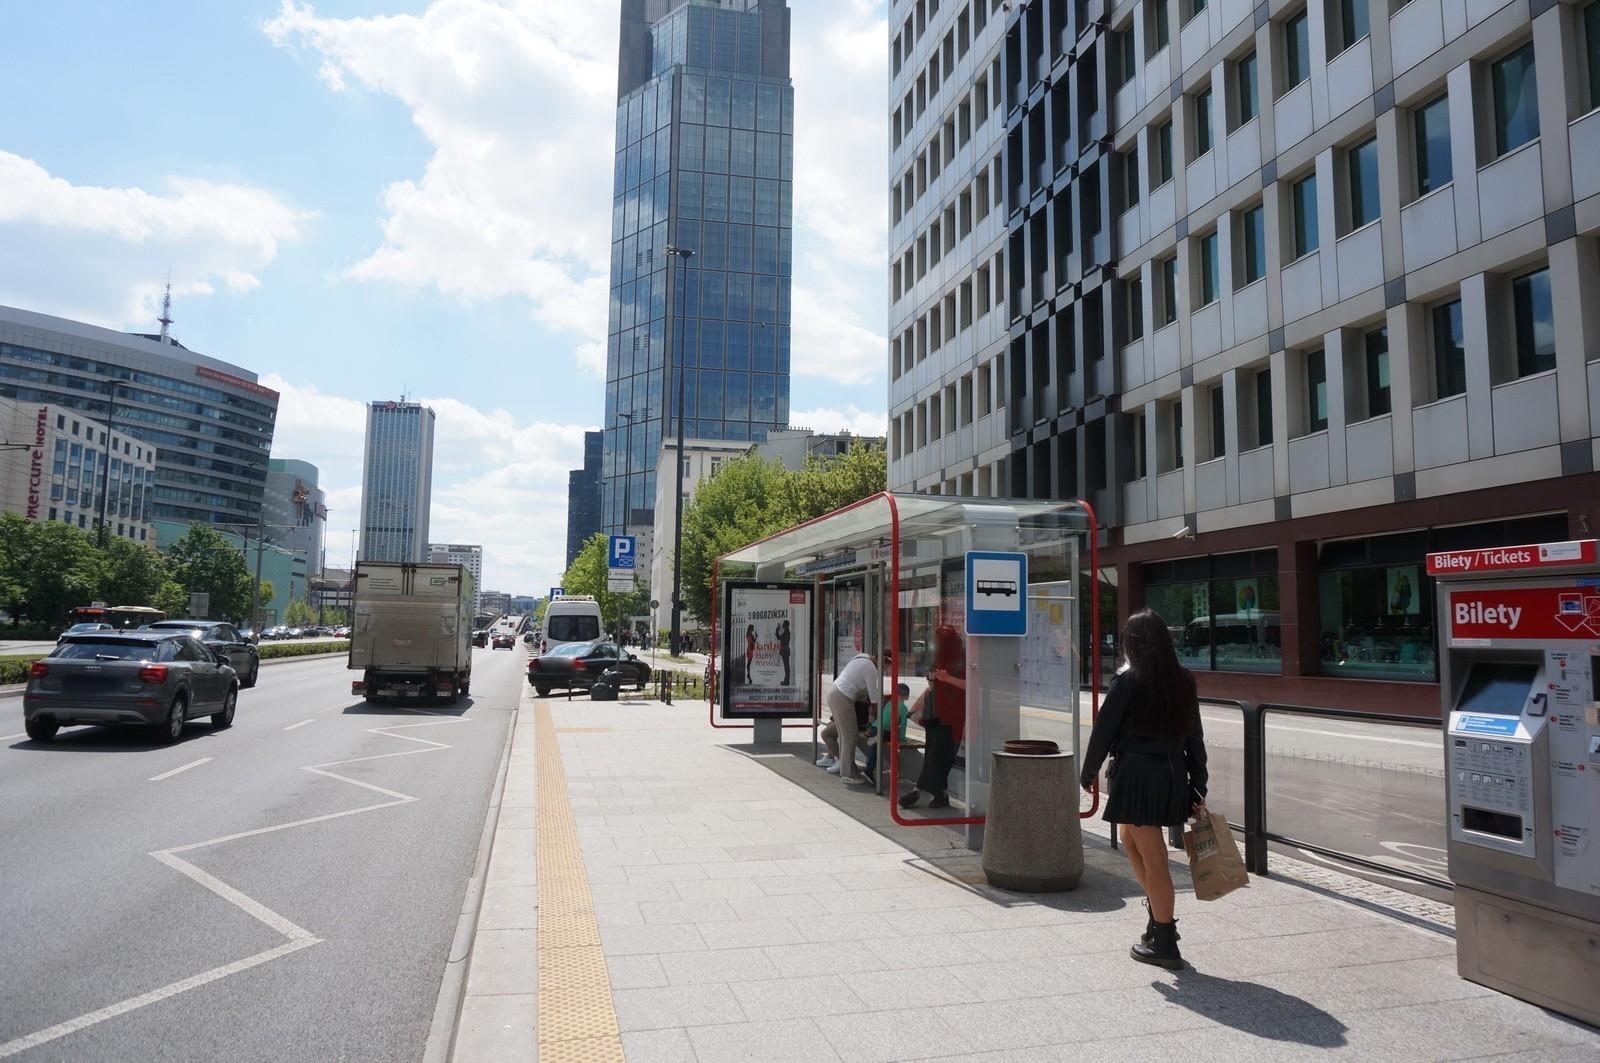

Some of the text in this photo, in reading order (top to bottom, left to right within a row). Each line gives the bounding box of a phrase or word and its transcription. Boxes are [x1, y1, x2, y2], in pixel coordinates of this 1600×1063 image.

[25, 406, 48, 519] mercure HOTEL
[615, 538, 630, 558] P
[1434, 550, 1531, 570] Bilety / Tickets
[1455, 601, 1522, 630] Bilety
